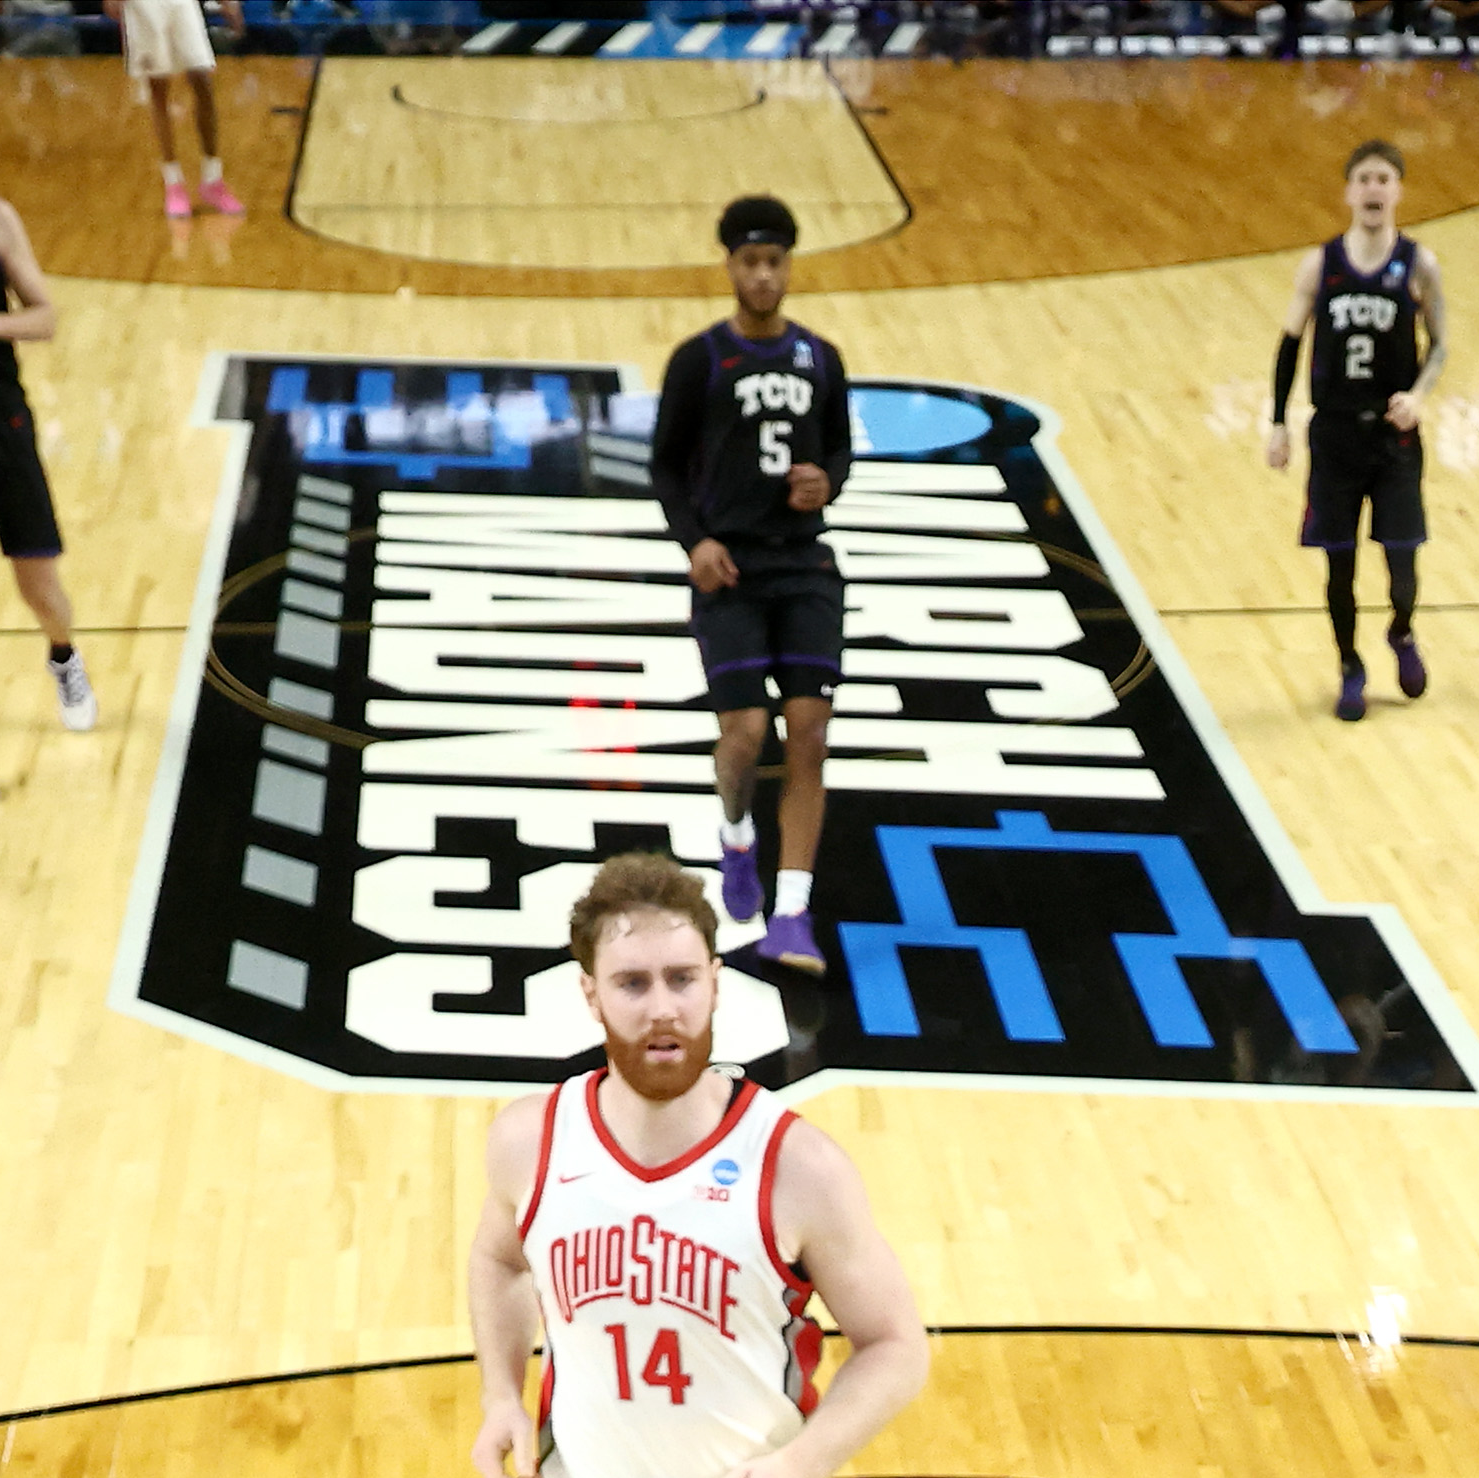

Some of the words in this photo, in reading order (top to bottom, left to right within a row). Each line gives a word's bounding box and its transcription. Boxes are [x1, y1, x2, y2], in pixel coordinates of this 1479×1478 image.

[1328, 293, 1399, 332] TCU
[1345, 334, 1376, 380] 2
[734, 371, 814, 418] TCU
[758, 419, 795, 476] 5
[765, 459, 1168, 800] MARCH
[345, 489, 791, 1064] MADNESS
[551, 1226, 625, 1324] OHIO
[631, 1214, 741, 1342] STATE
[603, 1322, 693, 1406] 14
